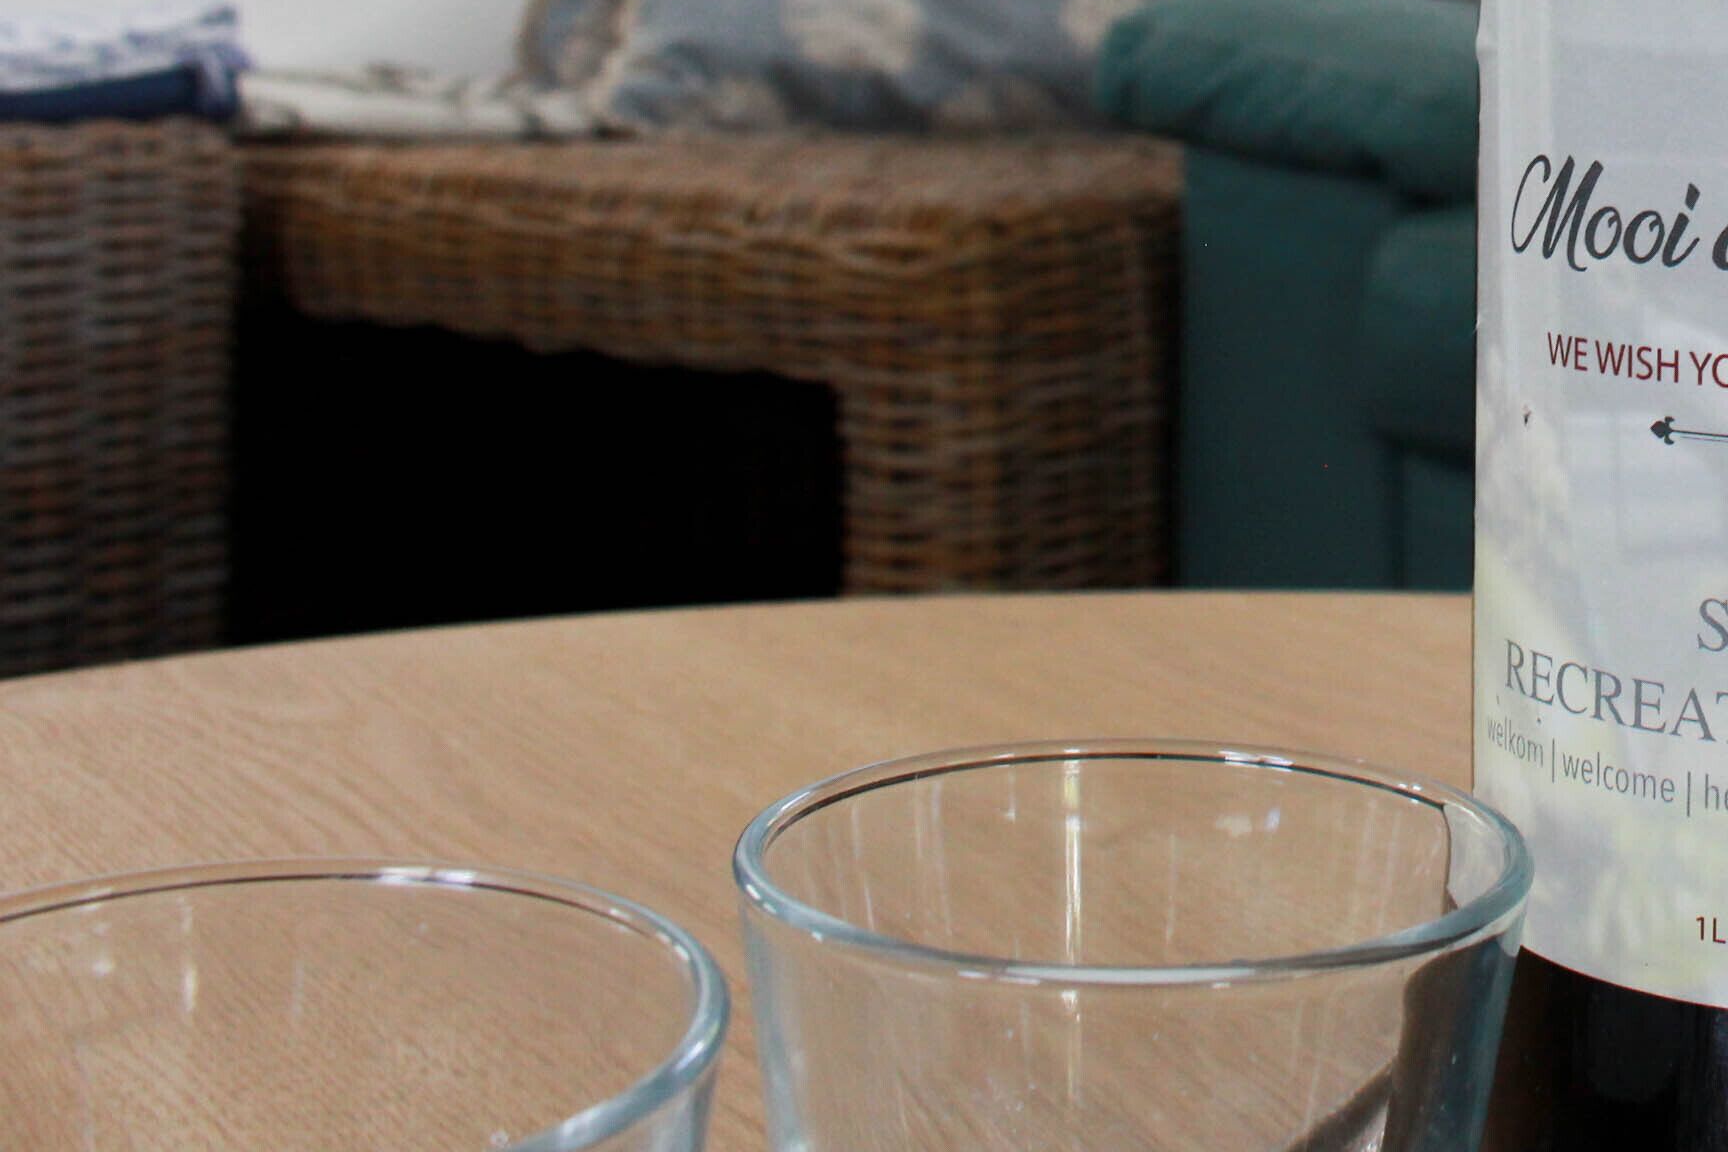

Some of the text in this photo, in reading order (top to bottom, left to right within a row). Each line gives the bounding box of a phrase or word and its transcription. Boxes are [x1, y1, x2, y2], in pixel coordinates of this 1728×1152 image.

[1511, 153, 1701, 273] Mooi
[1547, 331, 1589, 372] WE
[1594, 339, 1680, 384] WISH
[1486, 714, 1544, 767] welkom
[1561, 751, 1676, 803] welcome
[1695, 915, 1727, 945] 1L
